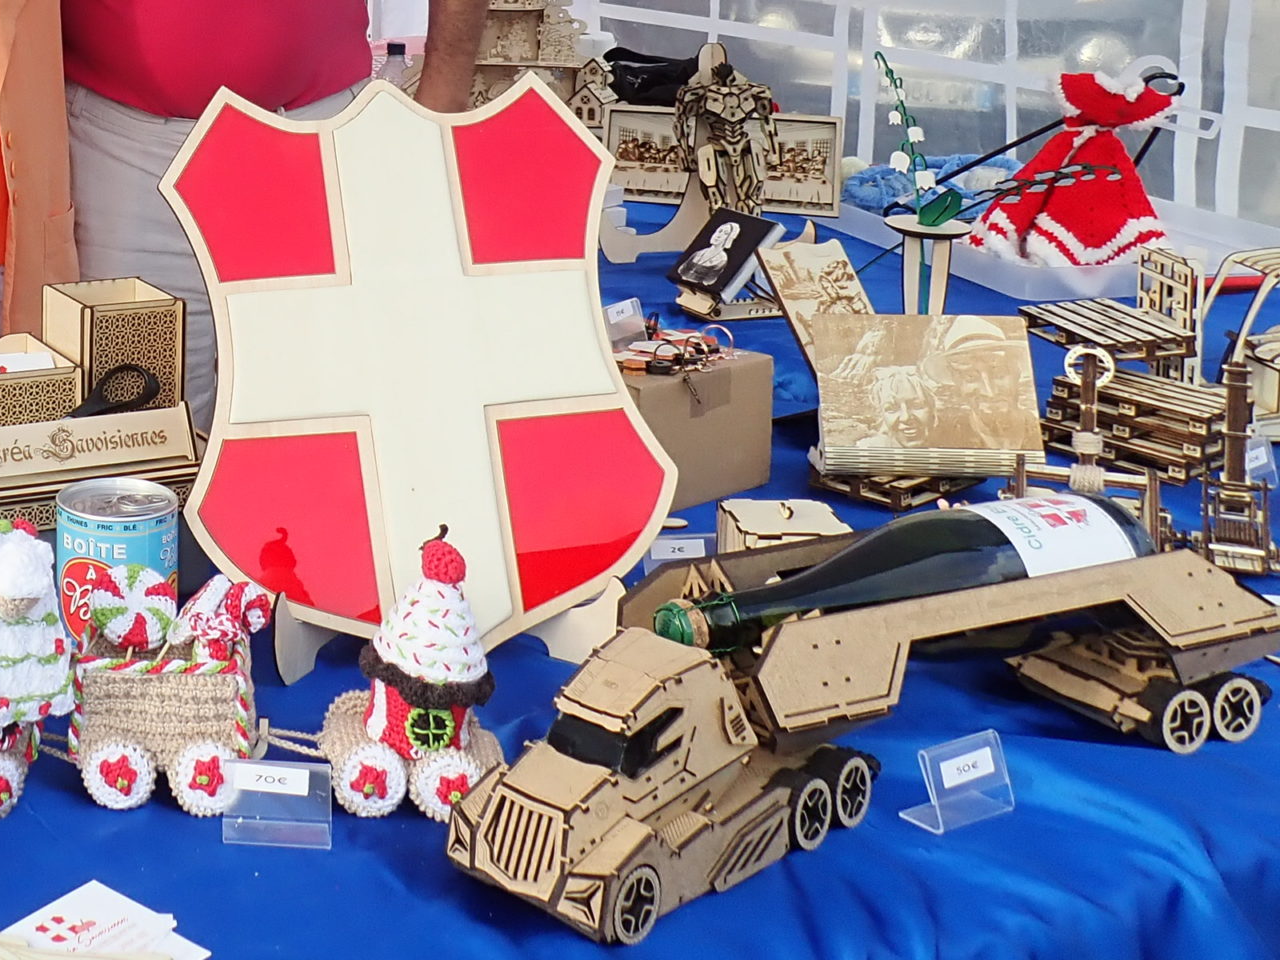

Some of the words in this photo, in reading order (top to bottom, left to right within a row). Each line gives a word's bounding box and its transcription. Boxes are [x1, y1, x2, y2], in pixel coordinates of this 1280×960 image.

[33, 424, 168, 465] Savoisiennes
[66, 516, 89, 528] THUNES
[96, 523, 113, 532] FRIC
[123, 523, 137, 532] BLÉ
[155, 516, 168, 526] FRIC
[1006, 515, 1042, 550] Cidre
[63, 532, 127, 559] BOÎTE
[85, 564, 97, 580] À
[956, 760, 979, 776] 50€
[255, 773, 288, 786] 70€
